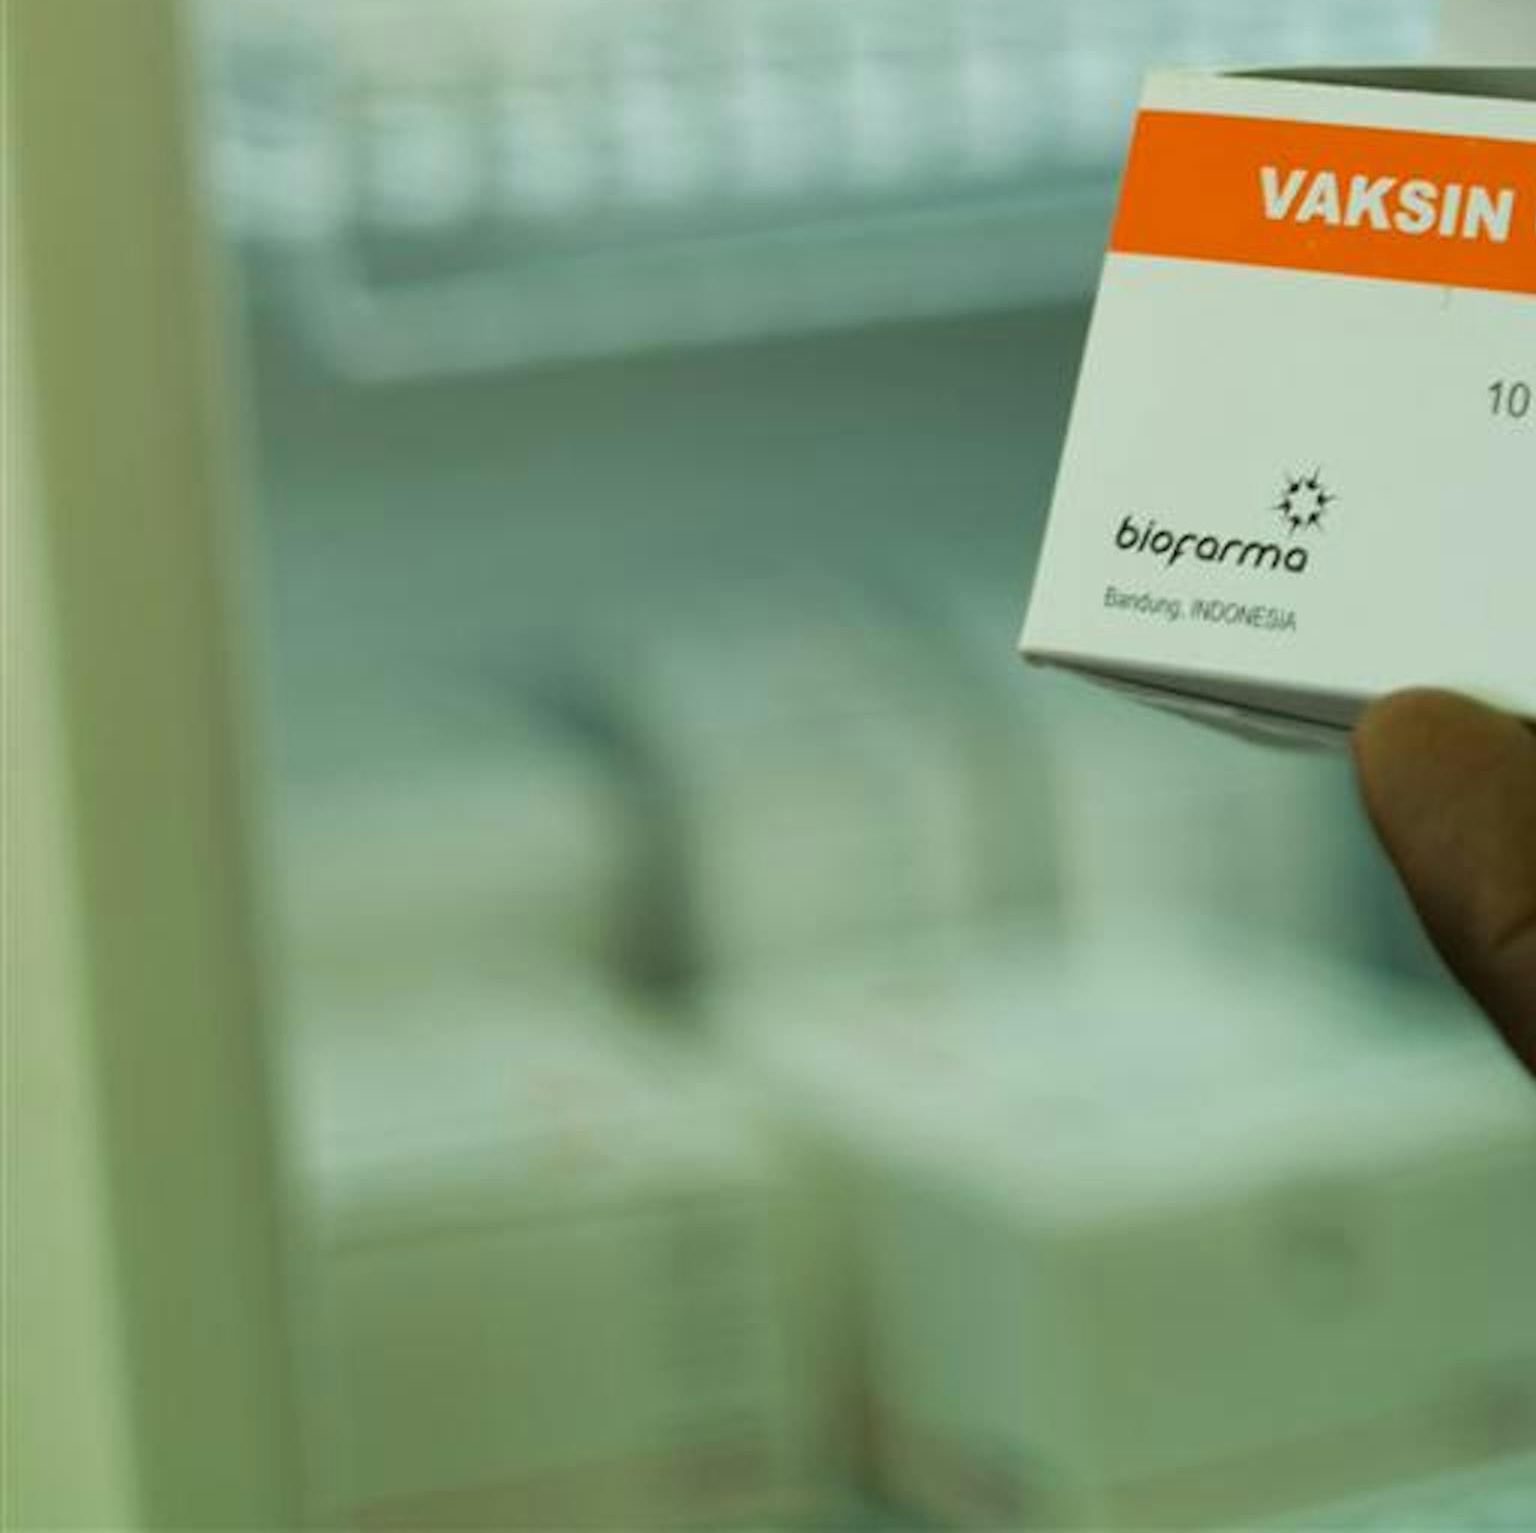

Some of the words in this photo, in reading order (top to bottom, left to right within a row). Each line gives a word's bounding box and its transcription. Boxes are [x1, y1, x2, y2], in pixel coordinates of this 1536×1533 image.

[1259, 165, 1515, 243] VAKSIN
[1487, 379, 1532, 420] 10
[1115, 515, 1309, 573] biofarma
[1189, 598, 1297, 632] INDONESIA
